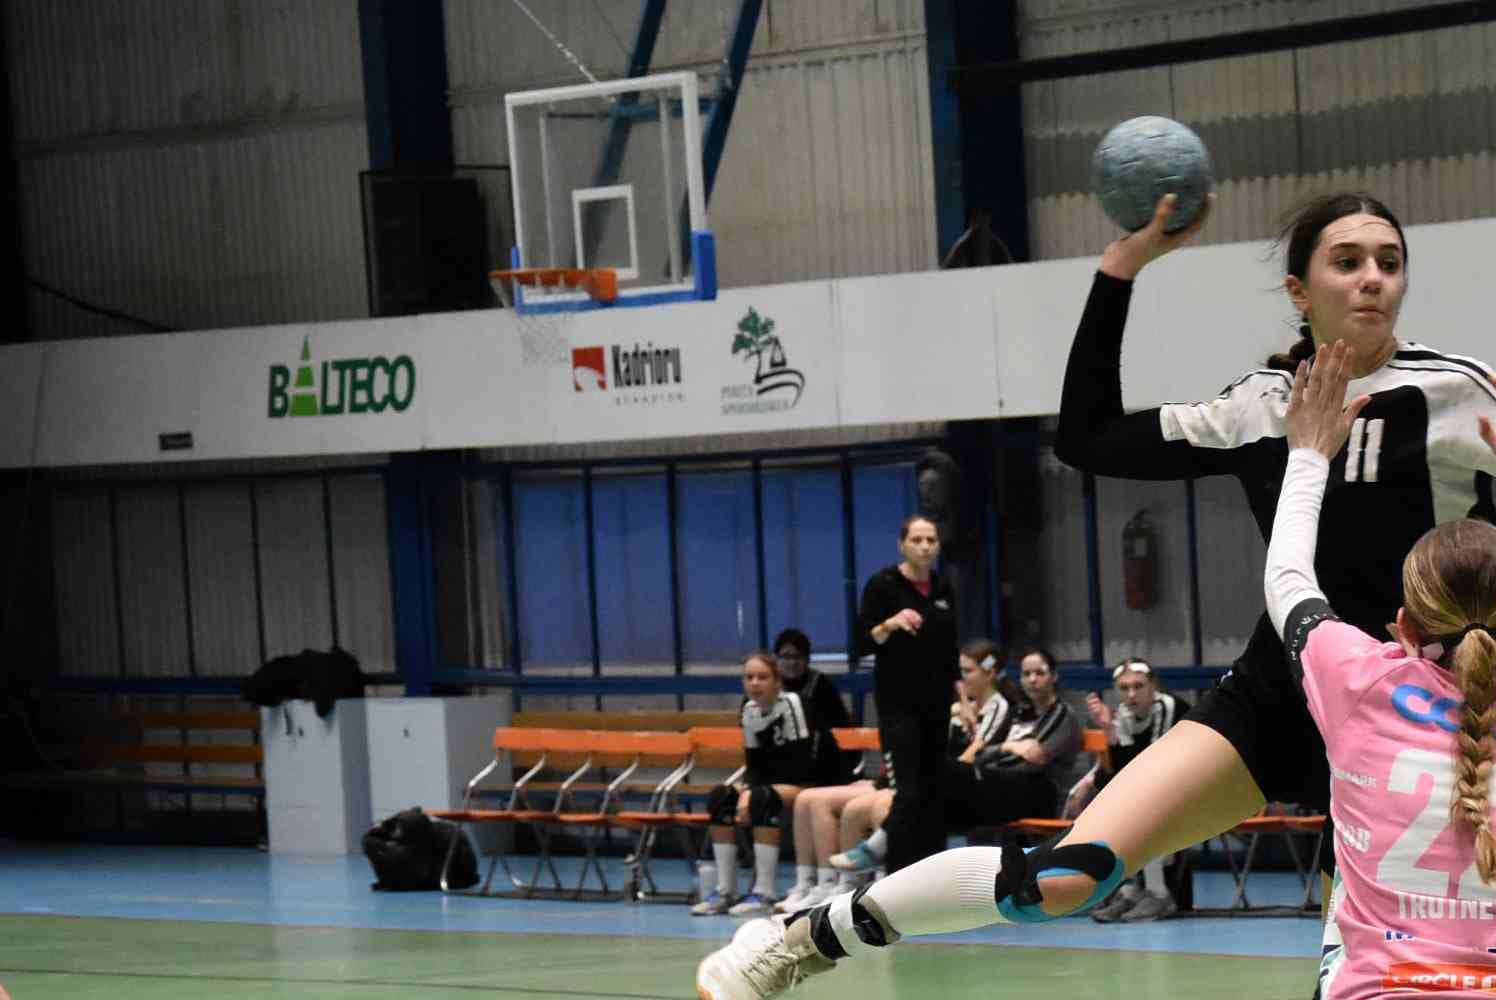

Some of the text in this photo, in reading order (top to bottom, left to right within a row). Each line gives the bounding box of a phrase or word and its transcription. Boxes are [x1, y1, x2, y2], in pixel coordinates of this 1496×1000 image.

[268, 335, 416, 419] BALTECO
[612, 342, 682, 388] Kadrioru
[1344, 417, 1384, 482] 11
